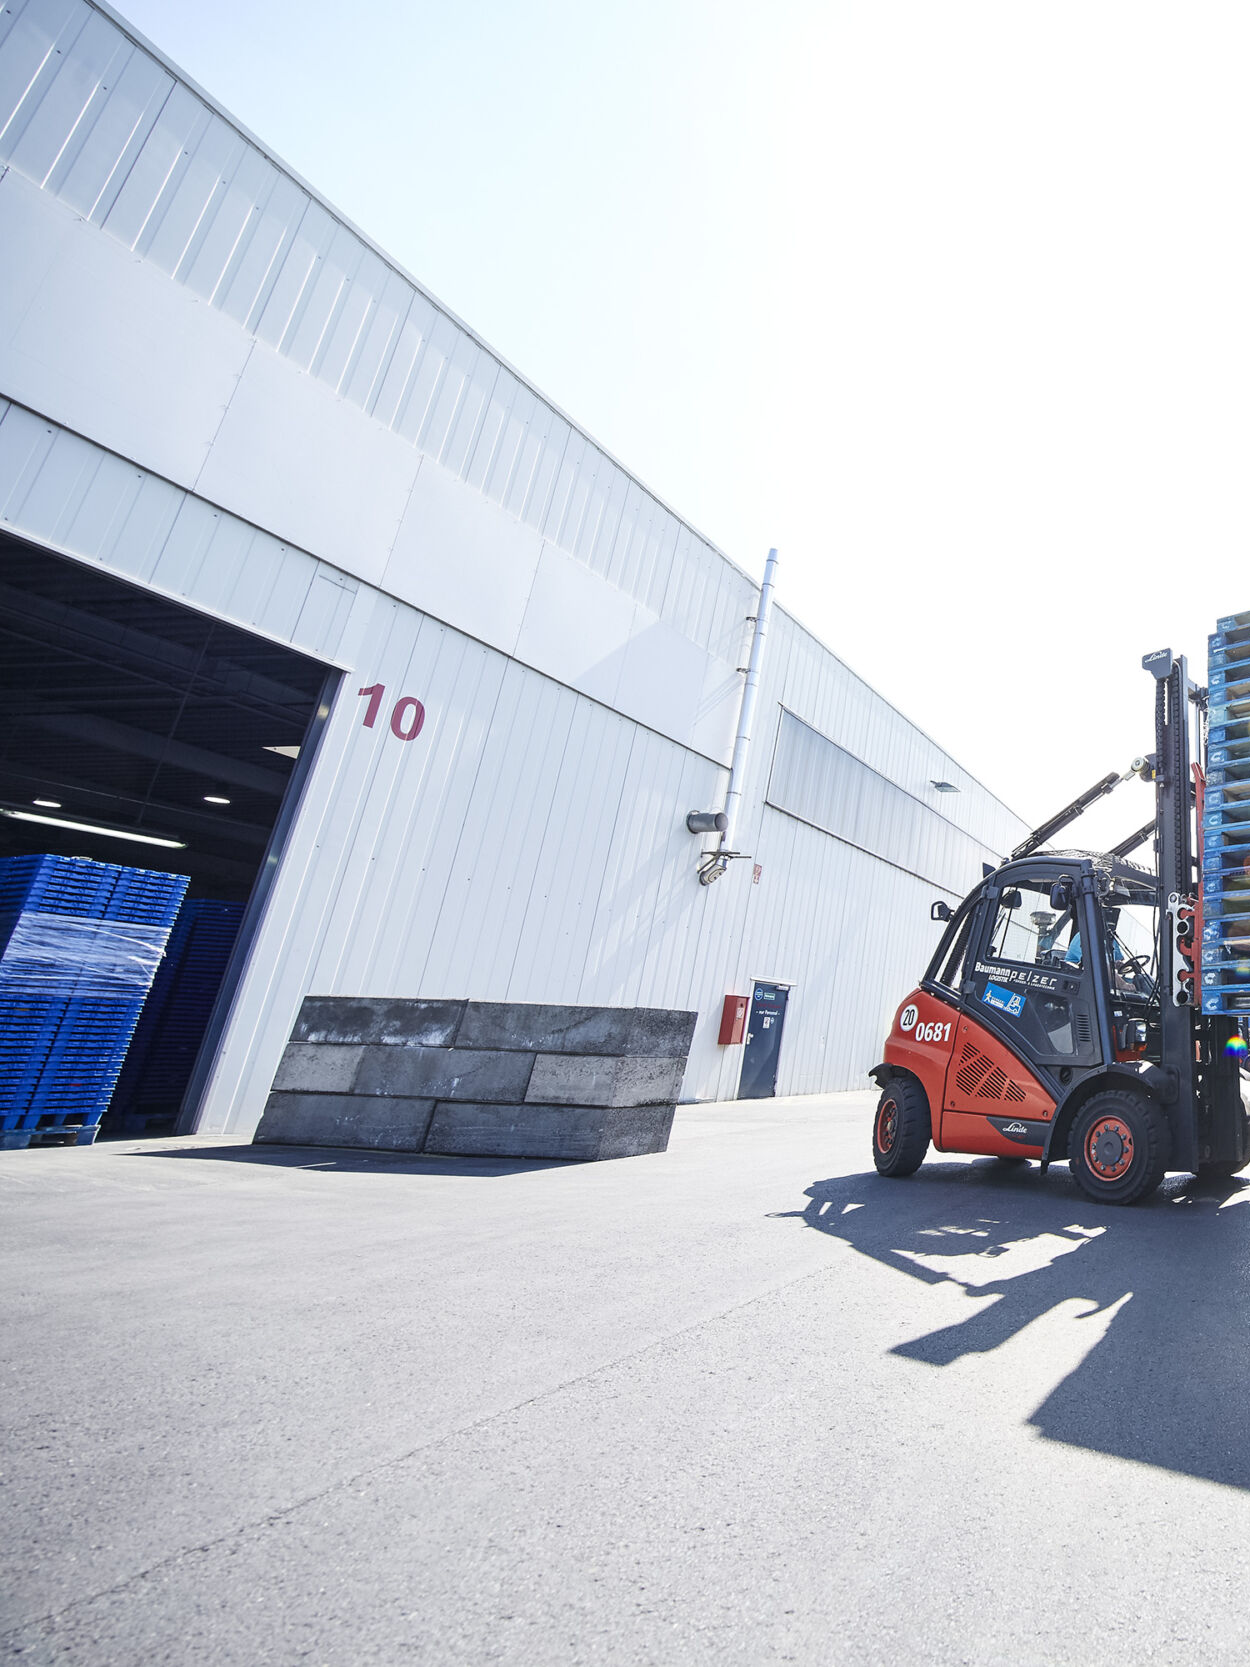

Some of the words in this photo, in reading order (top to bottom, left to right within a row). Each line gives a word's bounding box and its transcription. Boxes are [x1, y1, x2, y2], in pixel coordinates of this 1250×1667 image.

[357, 683, 426, 742] 10
[975, 962, 1010, 976] Baumann
[988, 975, 1008, 983] LOGISTIK
[903, 1009, 915, 1026] 20
[915, 1022, 952, 1042] 0681
[1002, 1121, 1028, 1134] Linde
